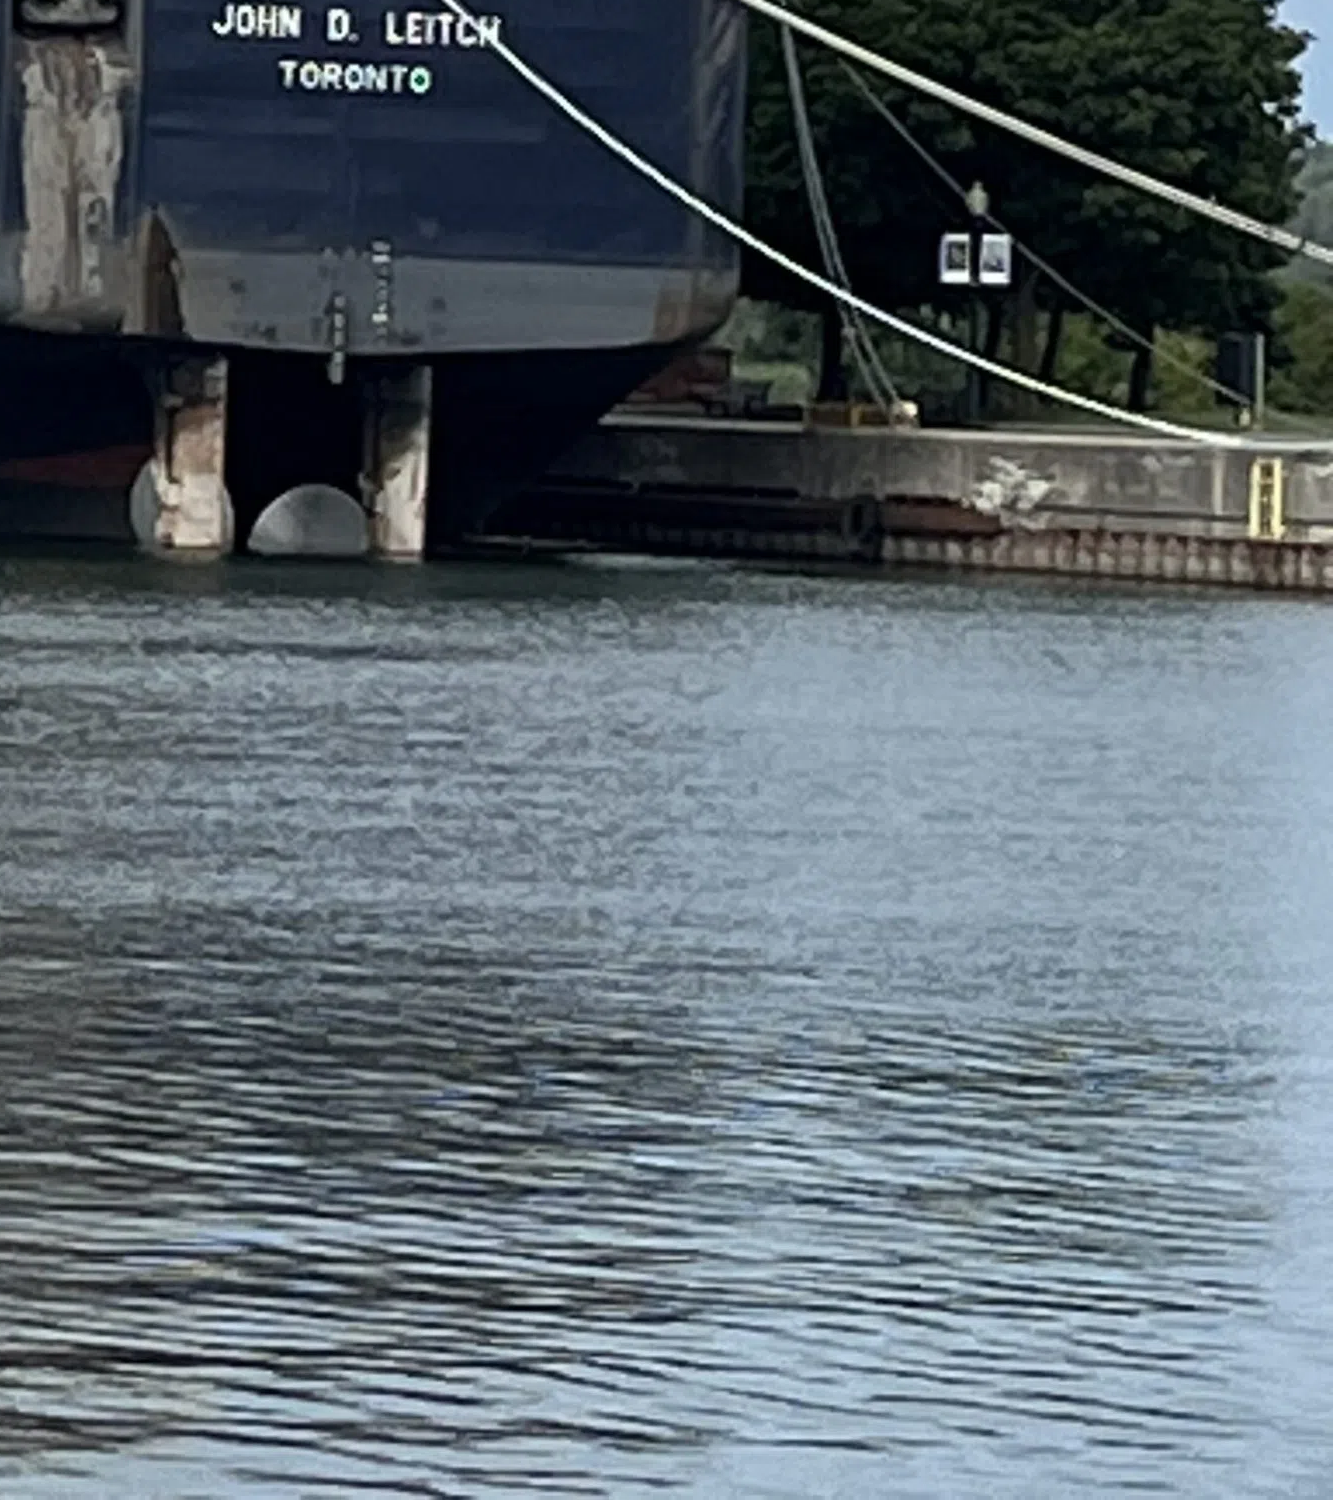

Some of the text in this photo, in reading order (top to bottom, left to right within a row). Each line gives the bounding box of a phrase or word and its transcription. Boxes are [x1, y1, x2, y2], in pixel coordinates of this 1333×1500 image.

[213, 3, 501, 48] JOHN D. LEITCH
[278, 60, 431, 94] TORONTO
